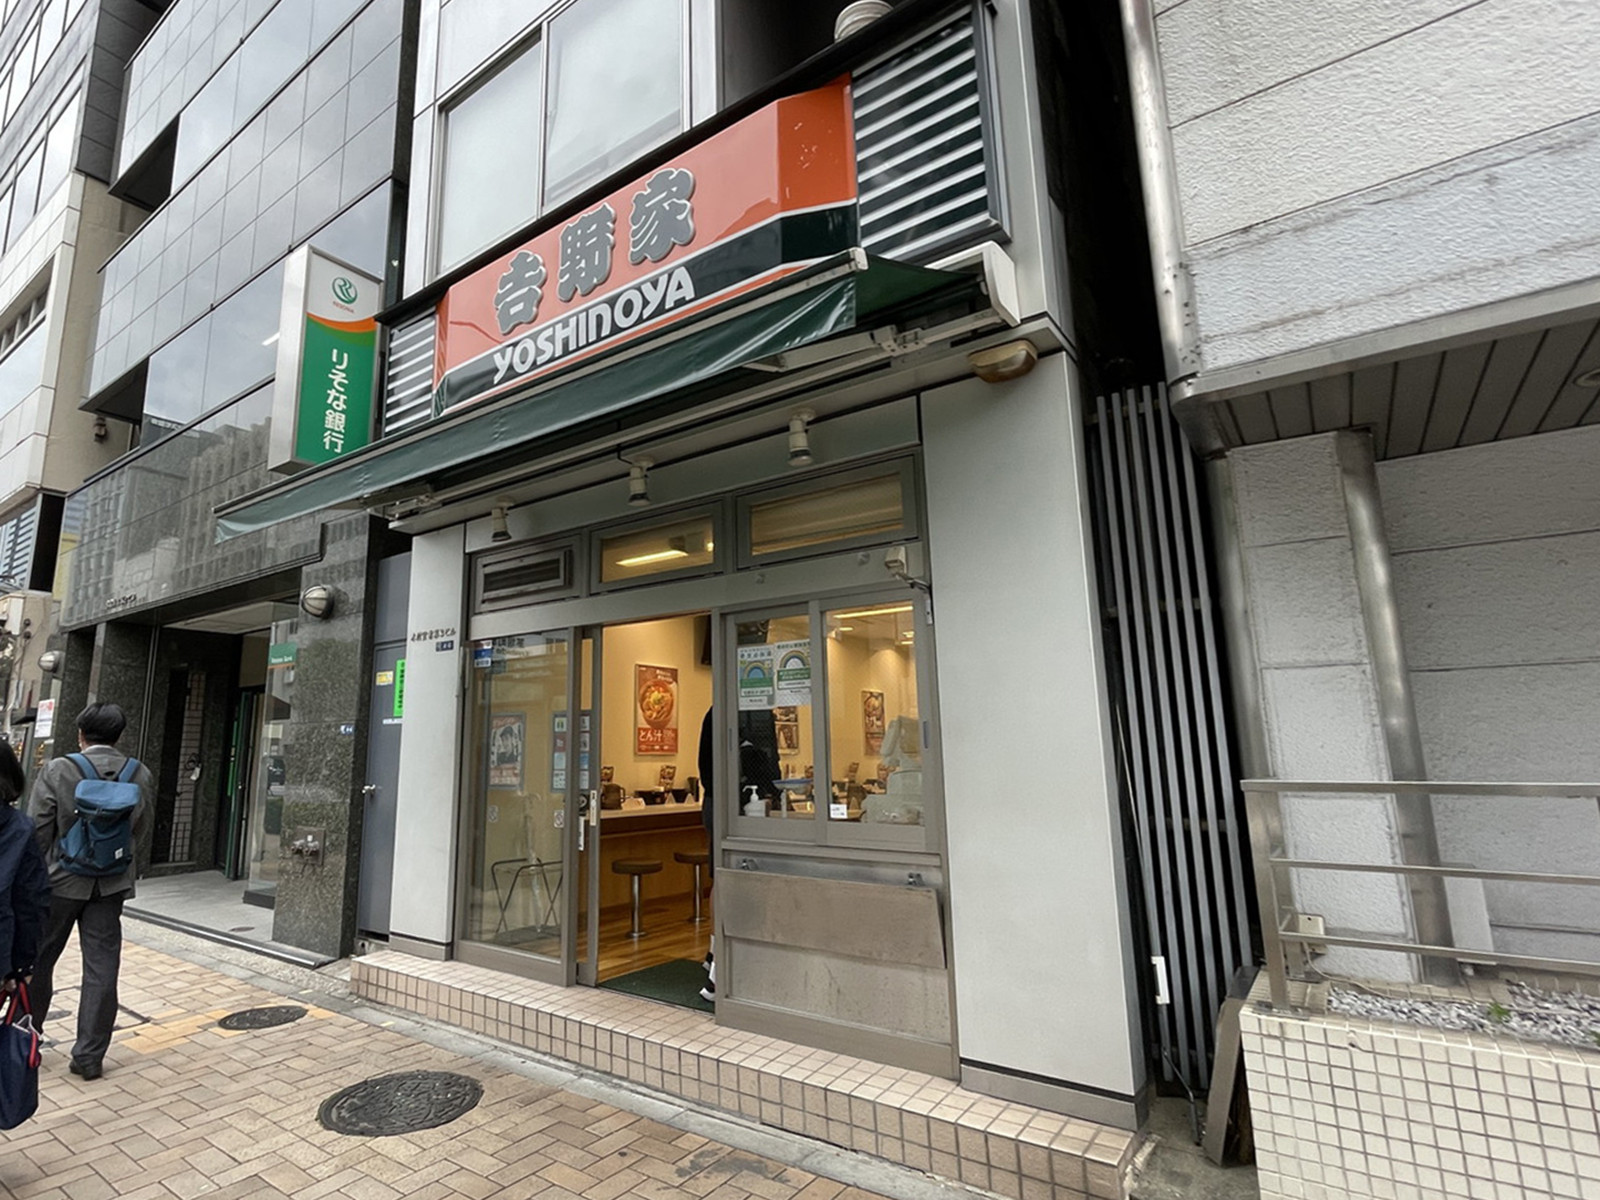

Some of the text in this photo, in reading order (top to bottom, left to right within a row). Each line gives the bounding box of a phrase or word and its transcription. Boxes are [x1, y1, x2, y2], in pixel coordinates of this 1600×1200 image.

[494, 168, 696, 336] 吉野家
[493, 266, 696, 385] YOSHINOYA
[323, 348, 349, 454] りそな銀行
